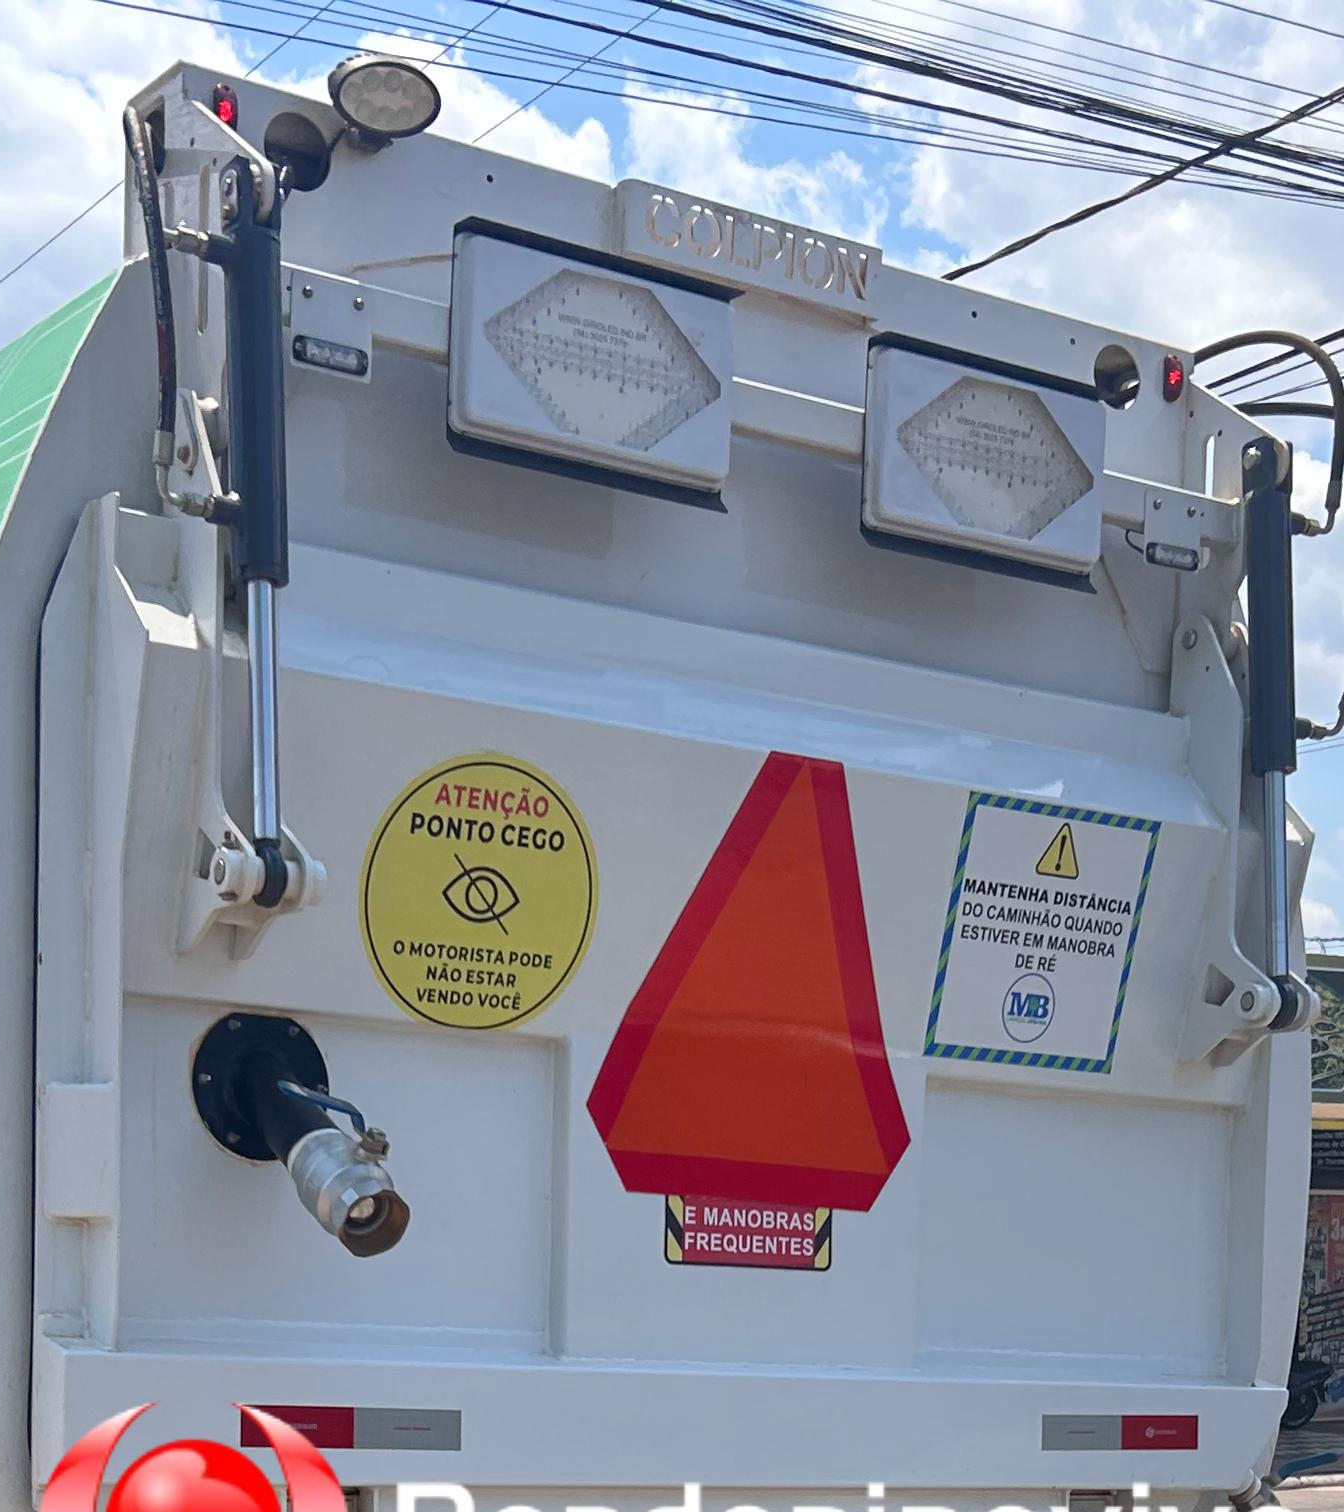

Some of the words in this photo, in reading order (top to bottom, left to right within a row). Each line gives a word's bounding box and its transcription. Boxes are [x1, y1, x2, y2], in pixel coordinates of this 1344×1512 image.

[644, 195, 869, 300] COLPION
[435, 783, 549, 820] ATENÇÃO
[410, 813, 495, 843] PONTO
[501, 824, 565, 852] CEGO
[964, 878, 1049, 903] MANTENHA
[1053, 892, 1132, 915] DISTÂNCIA
[962, 902, 983, 918] DO
[986, 905, 1061, 928] CAMINHÃO
[1064, 917, 1123, 937] QUANDO
[393, 940, 405, 955] O
[409, 942, 505, 965] MOTORISTA
[508, 951, 553, 969] PODE
[961, 925, 1020, 946] ESTIVER
[1023, 933, 1044, 949] EM
[1047, 937, 1115, 957] MANOBRA
[426, 964, 461, 983] NÃO
[466, 969, 516, 988] ESTAR
[1015, 954, 1033, 970] DE
[1037, 955, 1057, 972] RÉ
[416, 987, 473, 1006] VENDO
[478, 992, 521, 1011] VOCÊ
[1007, 991, 1050, 1019] MB
[685, 1206, 697, 1224] E
[704, 1207, 814, 1232] MANOBRAS
[684, 1232, 814, 1257] FREQUENTES
